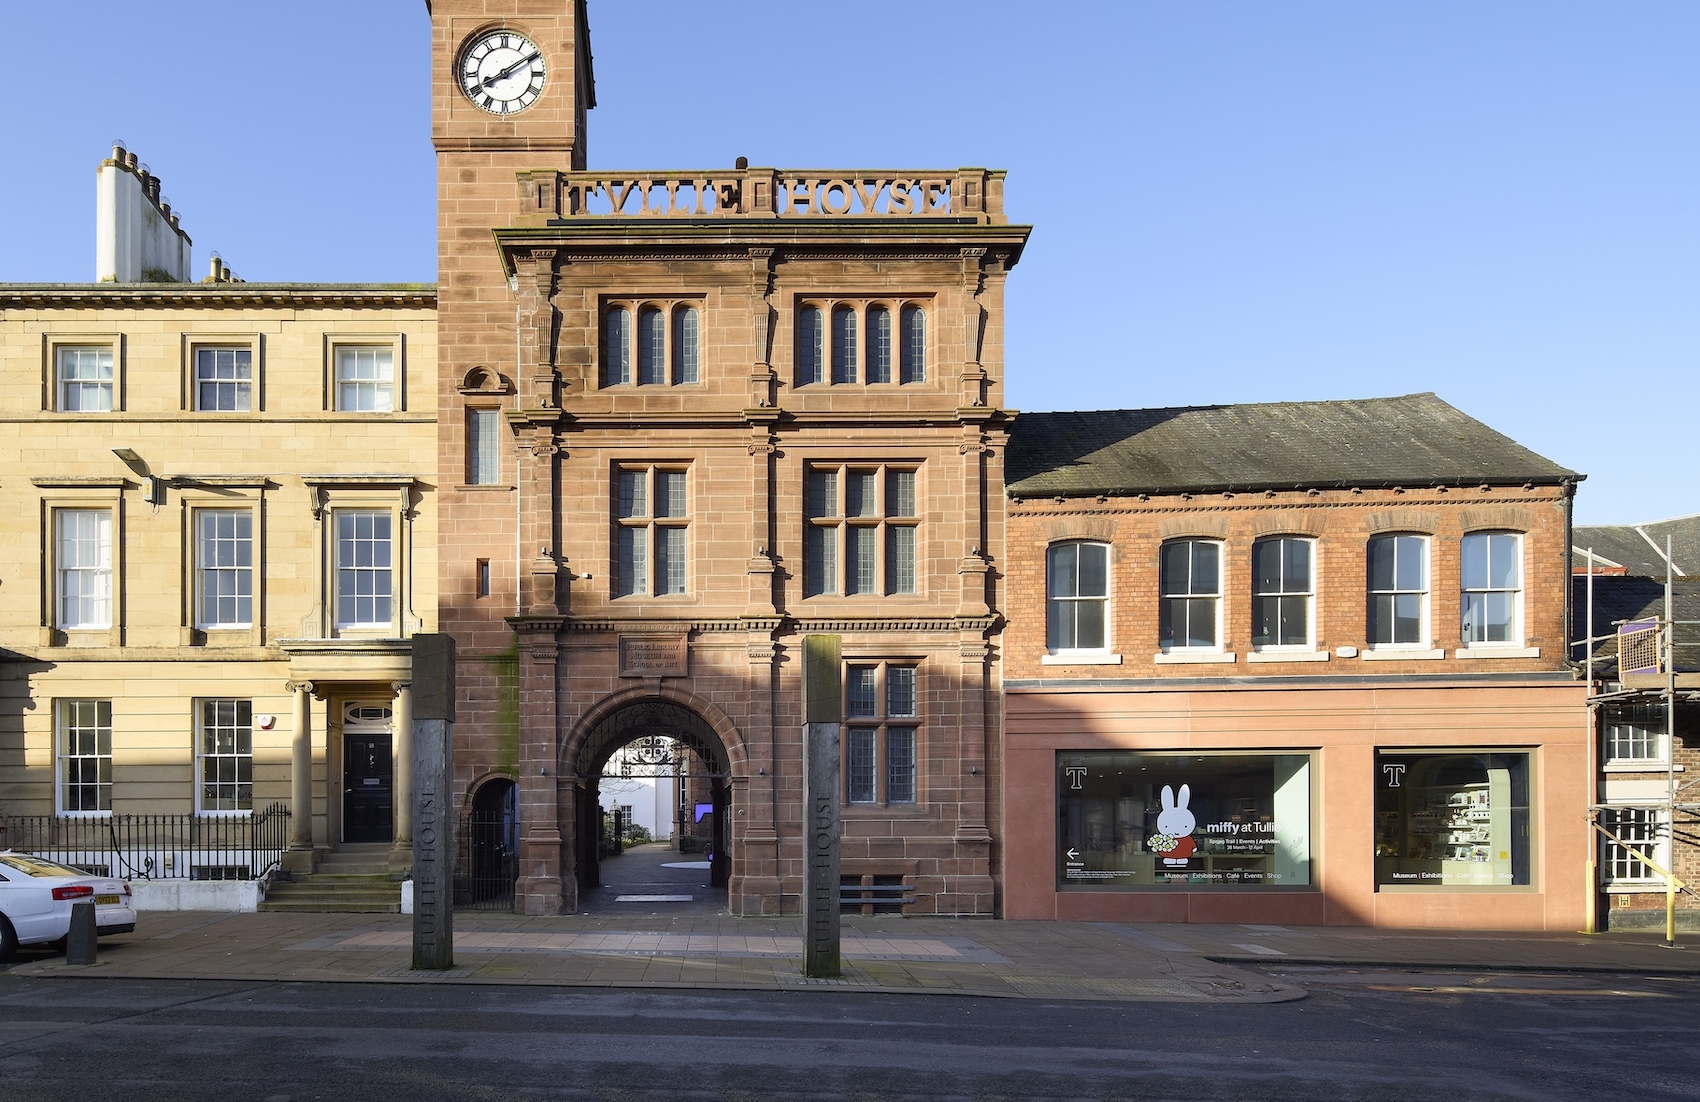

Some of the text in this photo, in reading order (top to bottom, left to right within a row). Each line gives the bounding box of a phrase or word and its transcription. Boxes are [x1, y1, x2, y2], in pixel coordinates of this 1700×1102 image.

[567, 179, 948, 215] TVLLIE HOVSE
[1206, 822, 1281, 835] miffy at Tullie
[421, 787, 437, 951] TULLIE HOUSE
[816, 792, 832, 960] TULLIE HOUSE
[1267, 872, 1282, 880] Shop
[1498, 872, 1514, 880] Shop
